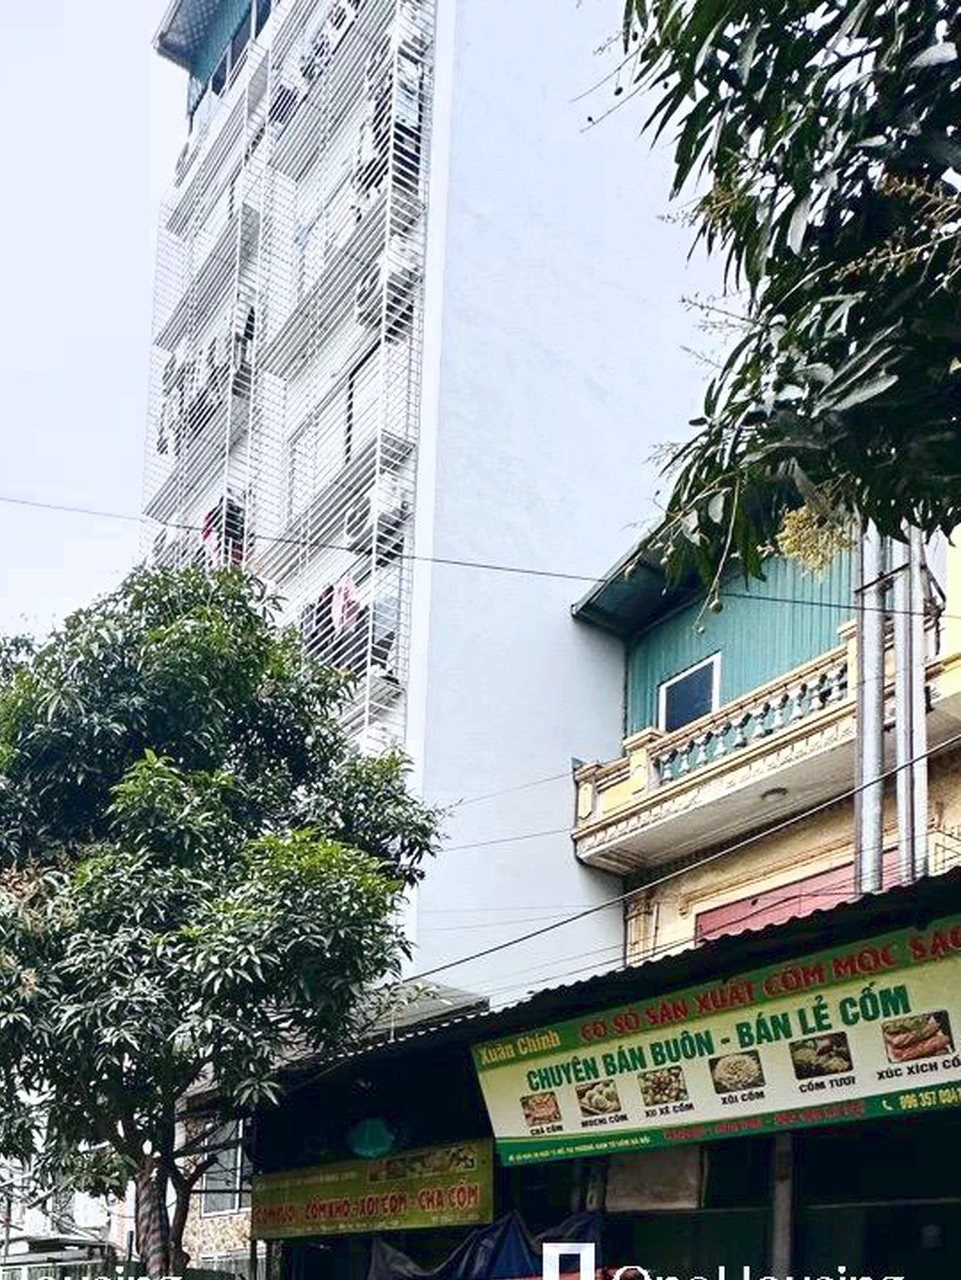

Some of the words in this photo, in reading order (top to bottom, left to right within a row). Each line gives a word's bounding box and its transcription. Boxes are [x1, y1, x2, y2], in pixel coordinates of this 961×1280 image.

[519, 1030, 561, 1055] Chính
[527, 1056, 600, 1092] CHUYÊN
[602, 1045, 647, 1077] BÁN
[650, 1030, 715, 1067] BUÔN
[736, 1012, 792, 1048] BÁN
[797, 994, 833, 1035] LẺ
[840, 981, 912, 1027] CỐM
